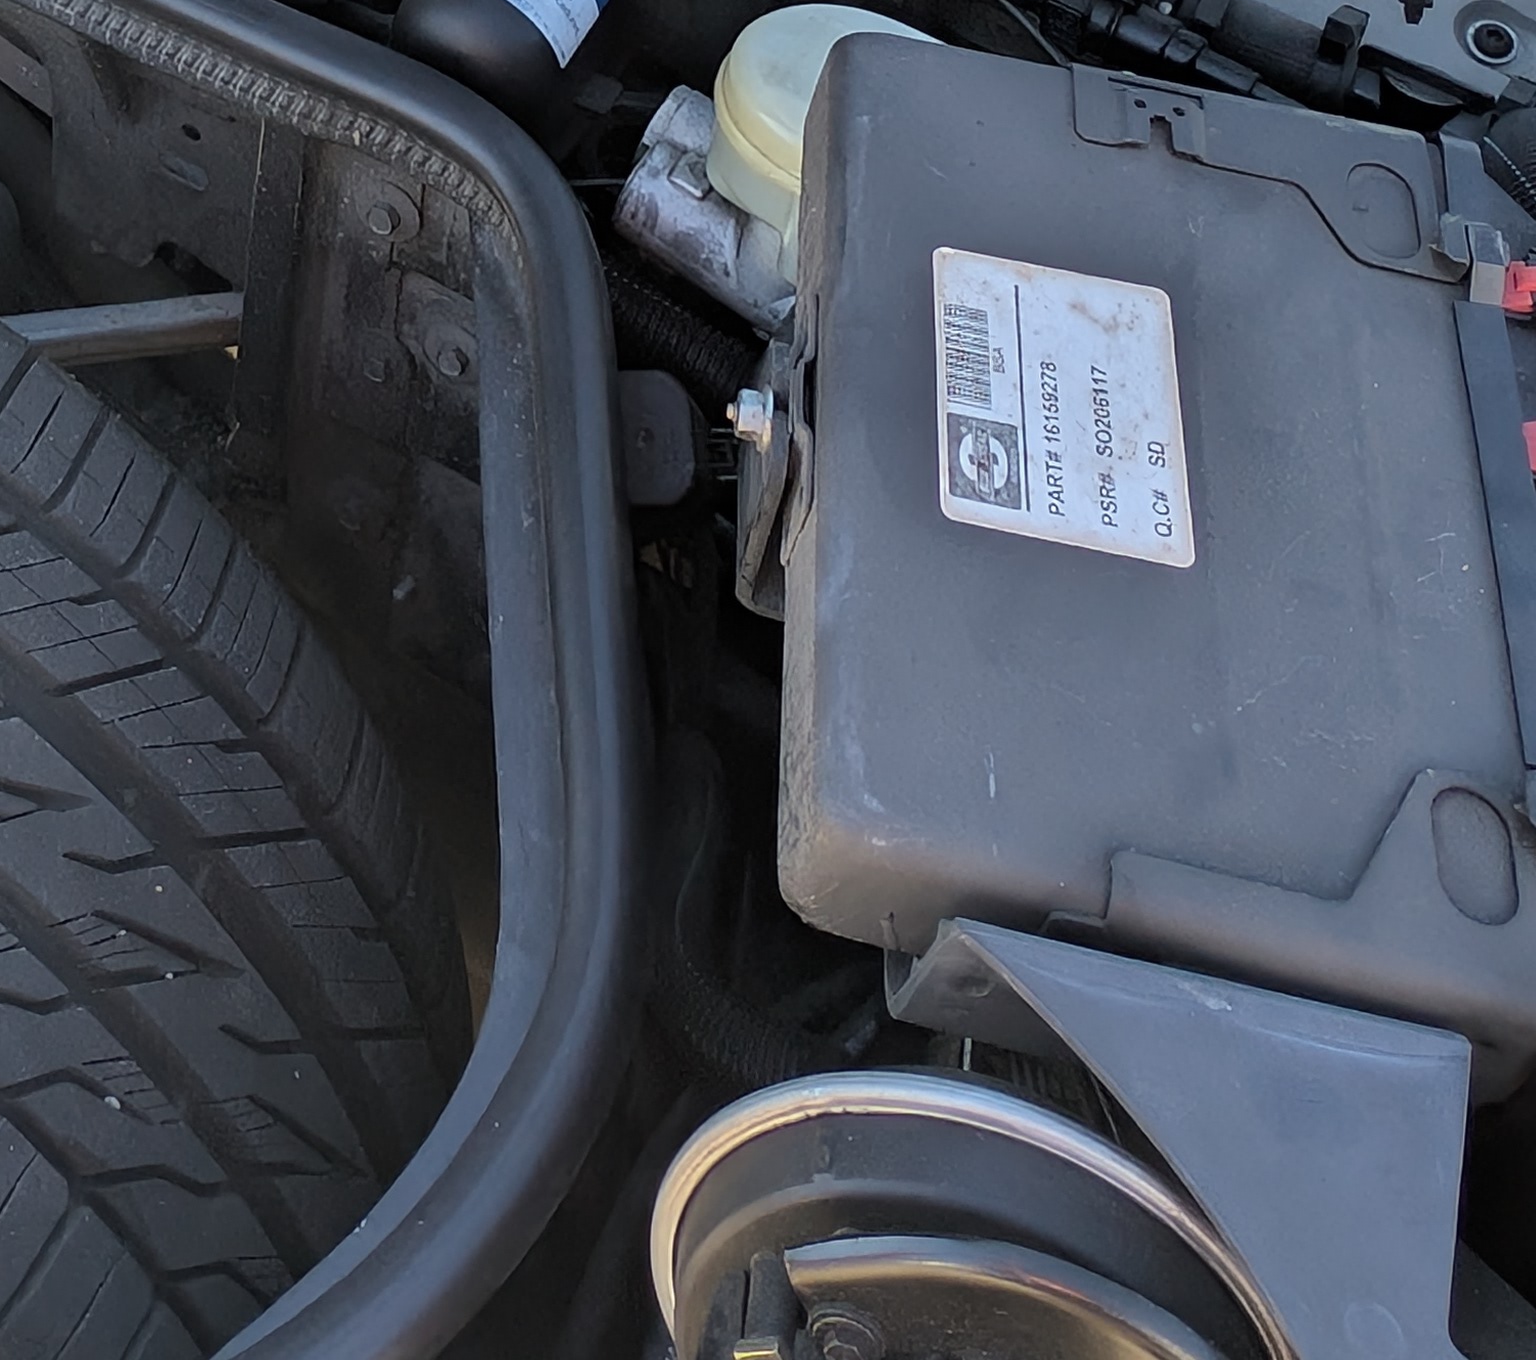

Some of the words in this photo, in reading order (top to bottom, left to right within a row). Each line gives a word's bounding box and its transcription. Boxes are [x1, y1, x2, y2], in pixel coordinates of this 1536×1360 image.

[1039, 360, 1063, 443] 16159278
[1042, 449, 1066, 517] PART#
[1146, 440, 1167, 468] SD
[1098, 472, 1119, 528] PSR#
